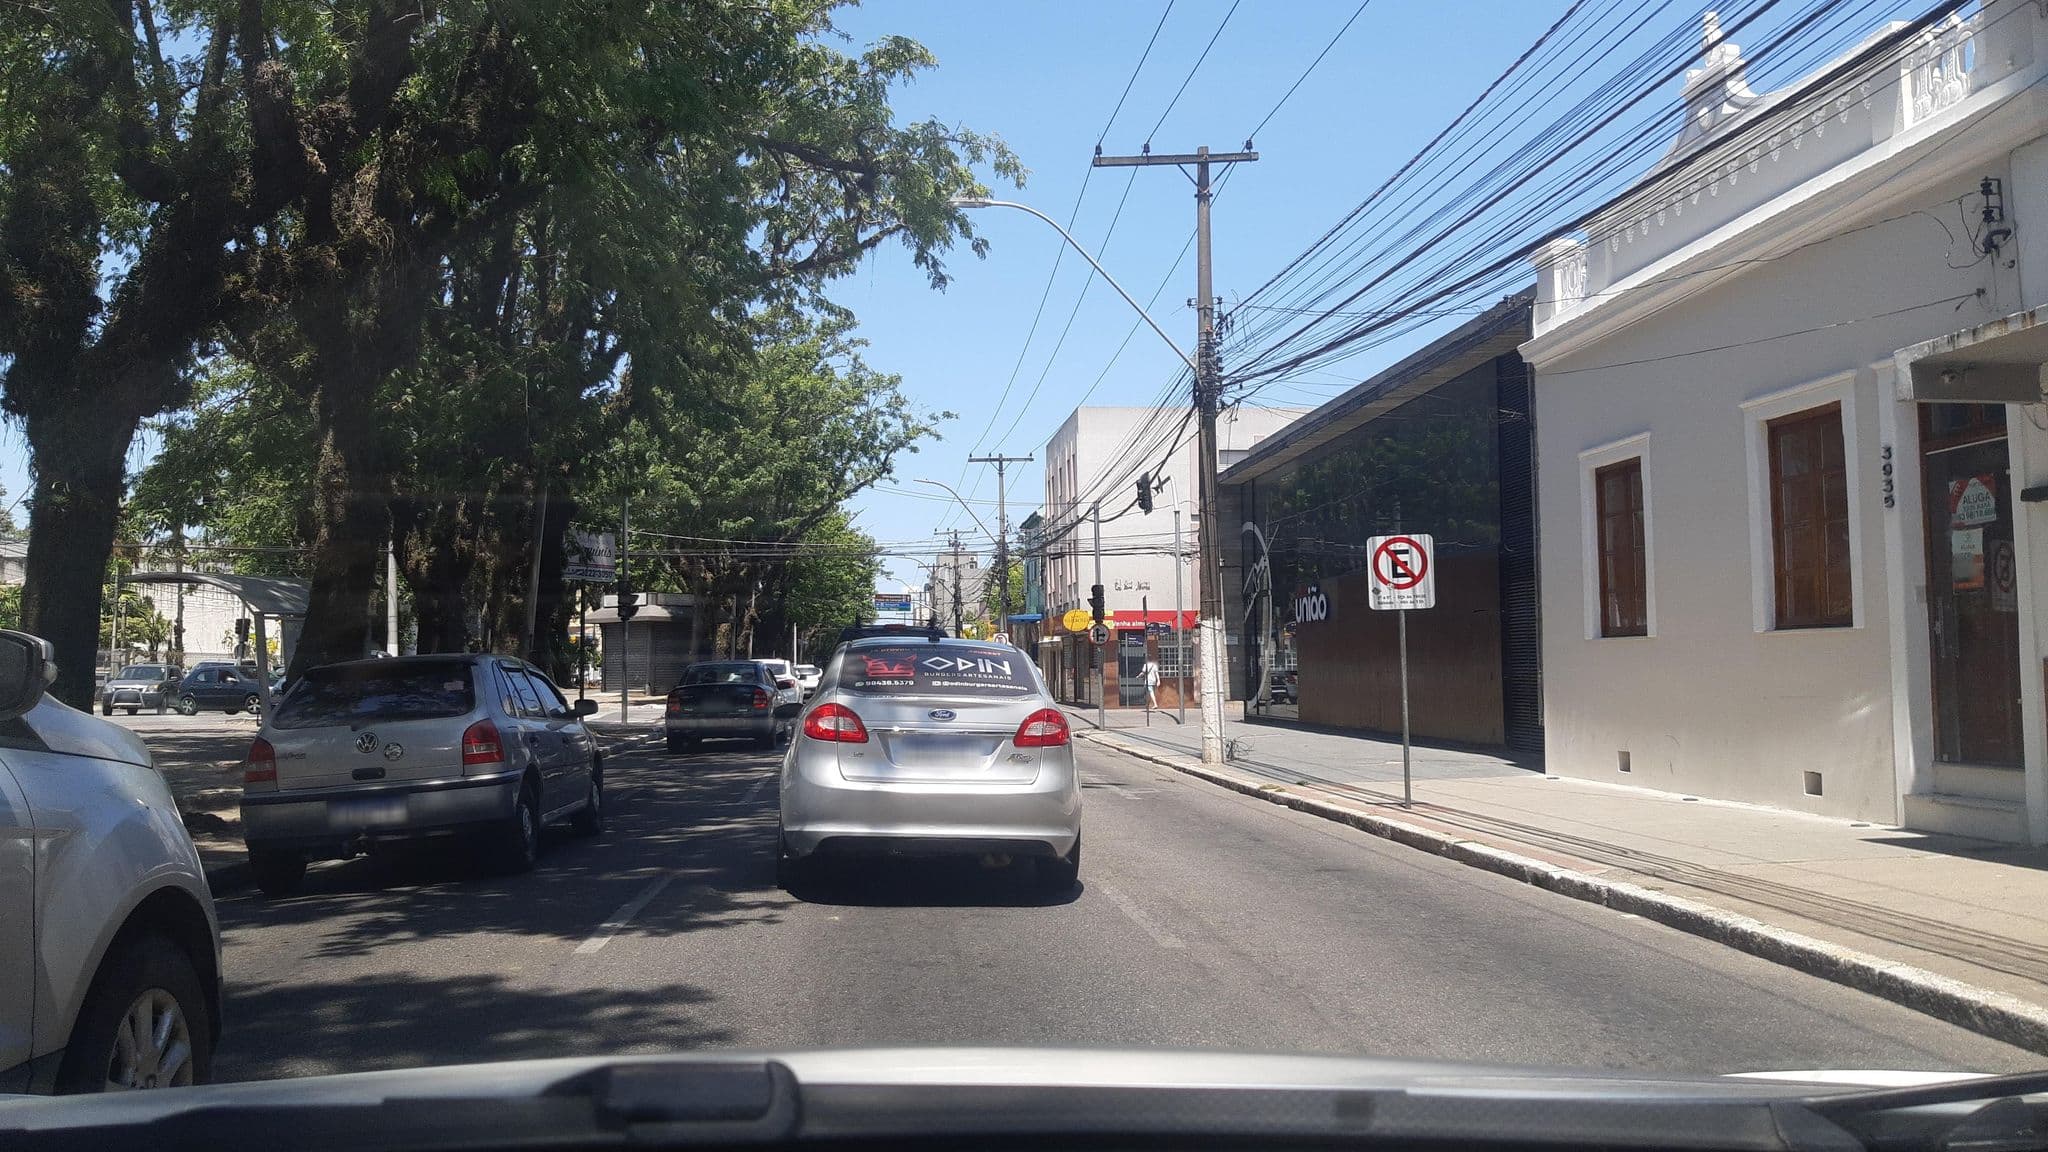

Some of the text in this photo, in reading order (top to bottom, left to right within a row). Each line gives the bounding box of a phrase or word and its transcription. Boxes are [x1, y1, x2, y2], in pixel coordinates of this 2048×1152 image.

[1881, 445, 1895, 508] 3935
[1295, 586, 1327, 623] união
[922, 656, 1012, 675] ODIN
[962, 673, 1012, 681] ARTESANAIS
[931, 710, 954, 720] Ford
